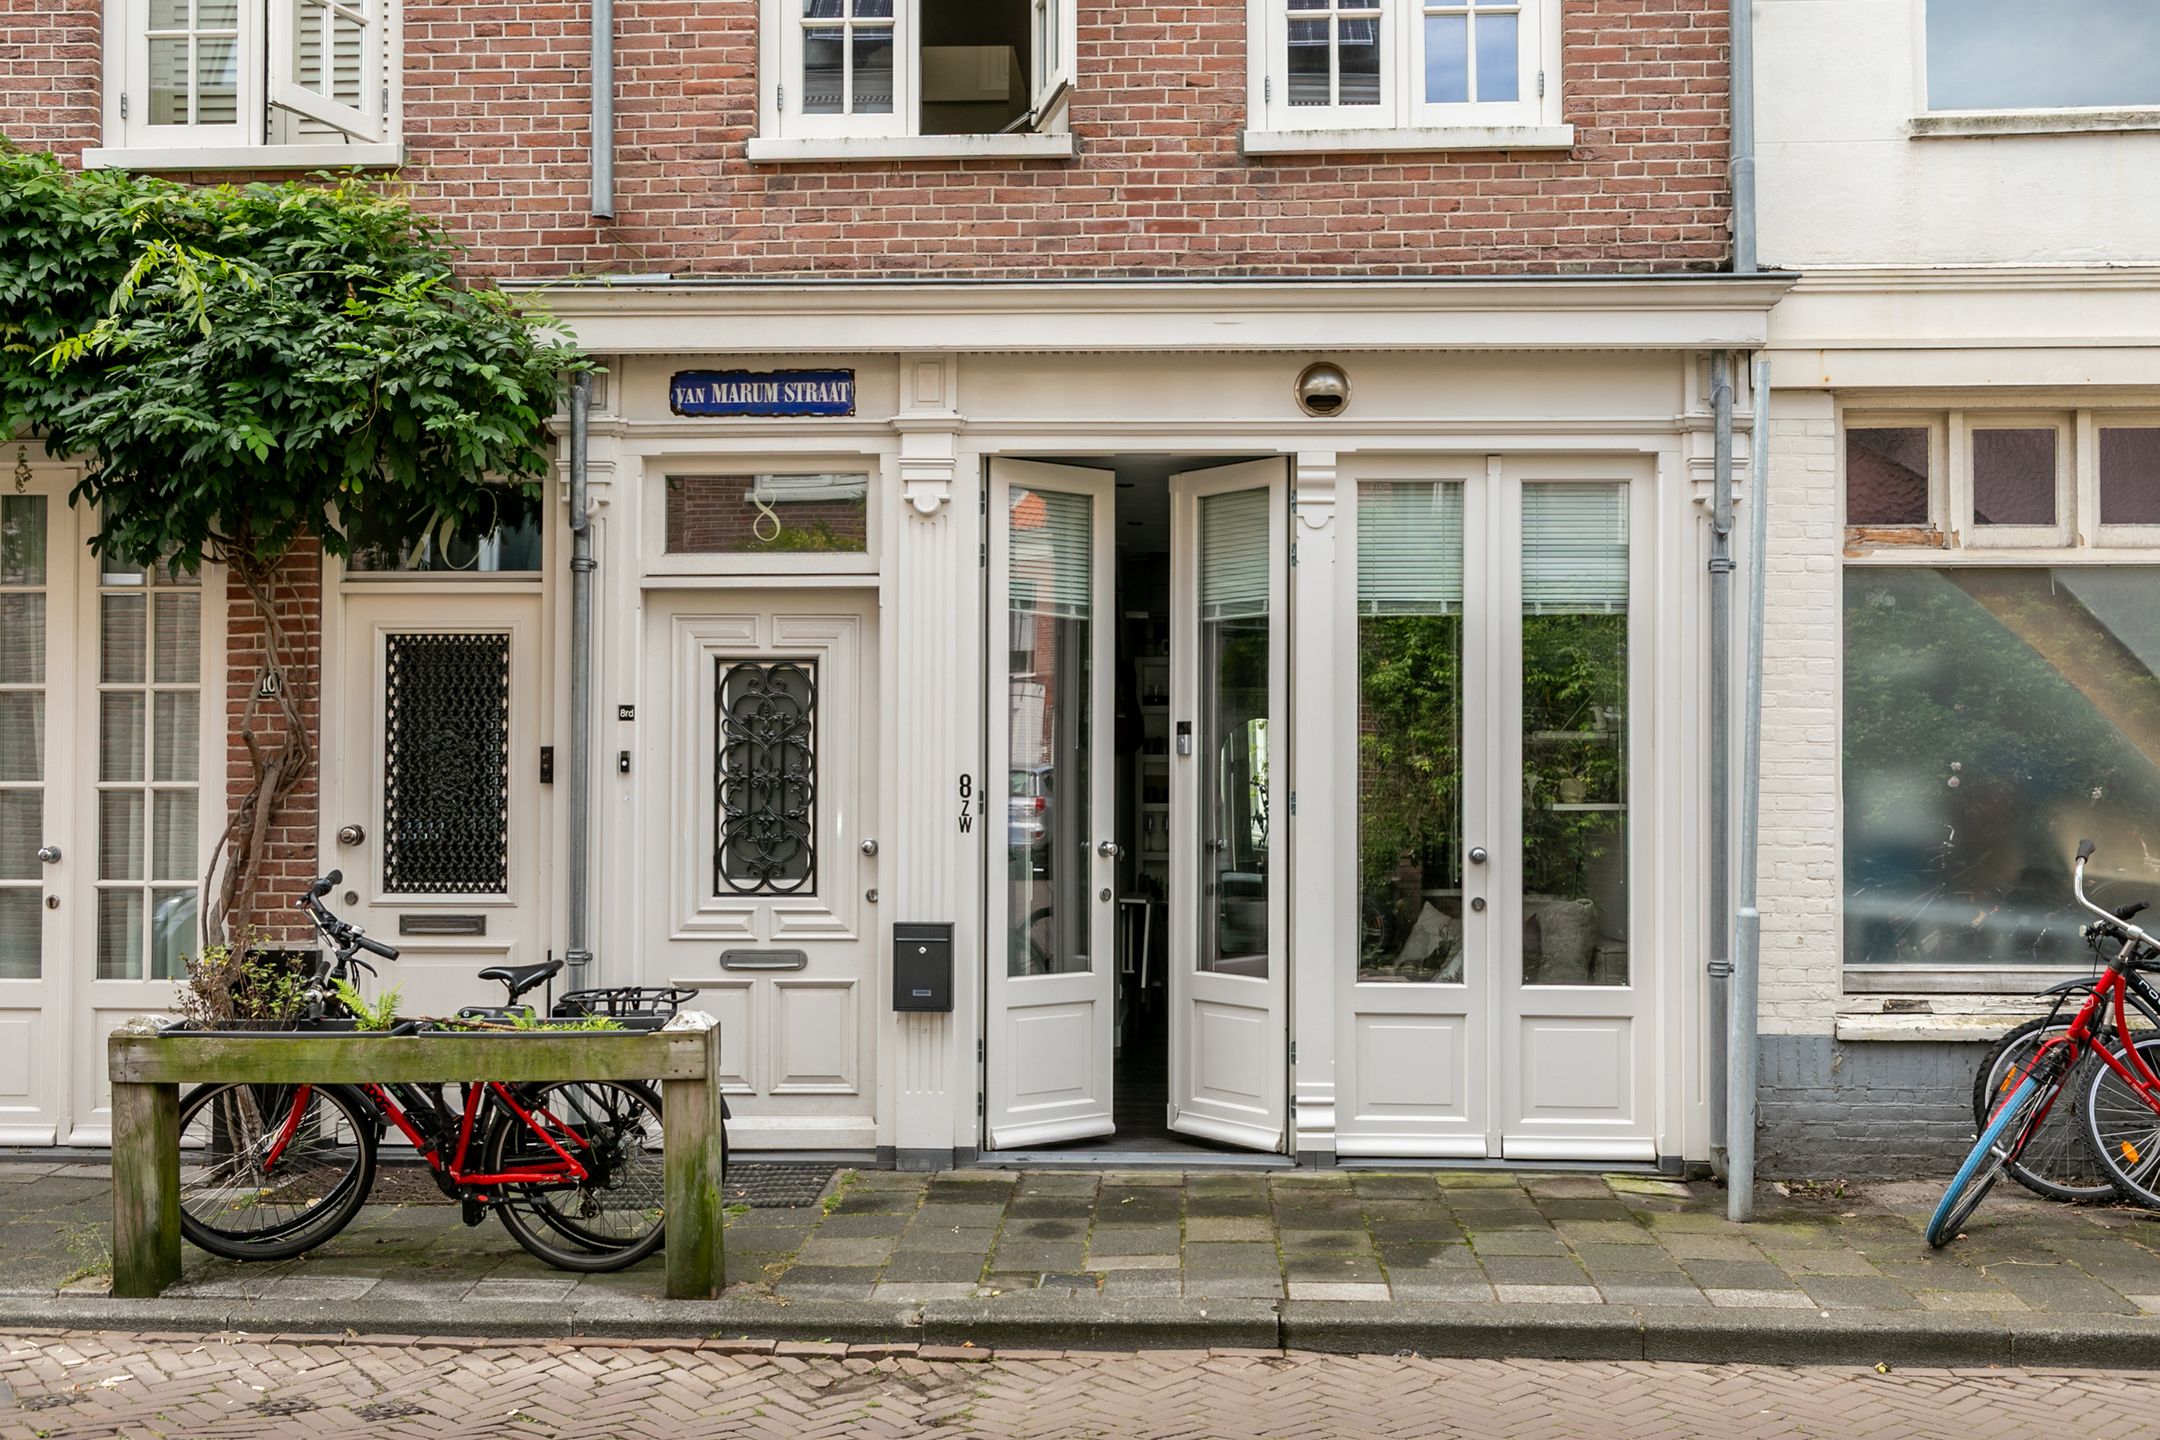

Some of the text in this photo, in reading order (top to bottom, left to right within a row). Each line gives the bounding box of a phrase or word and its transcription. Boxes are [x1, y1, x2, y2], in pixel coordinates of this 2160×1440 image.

[675, 382, 849, 403] VAN MARUM STRAAT
[753, 488, 781, 542] 8
[620, 708, 634, 718] 8rd
